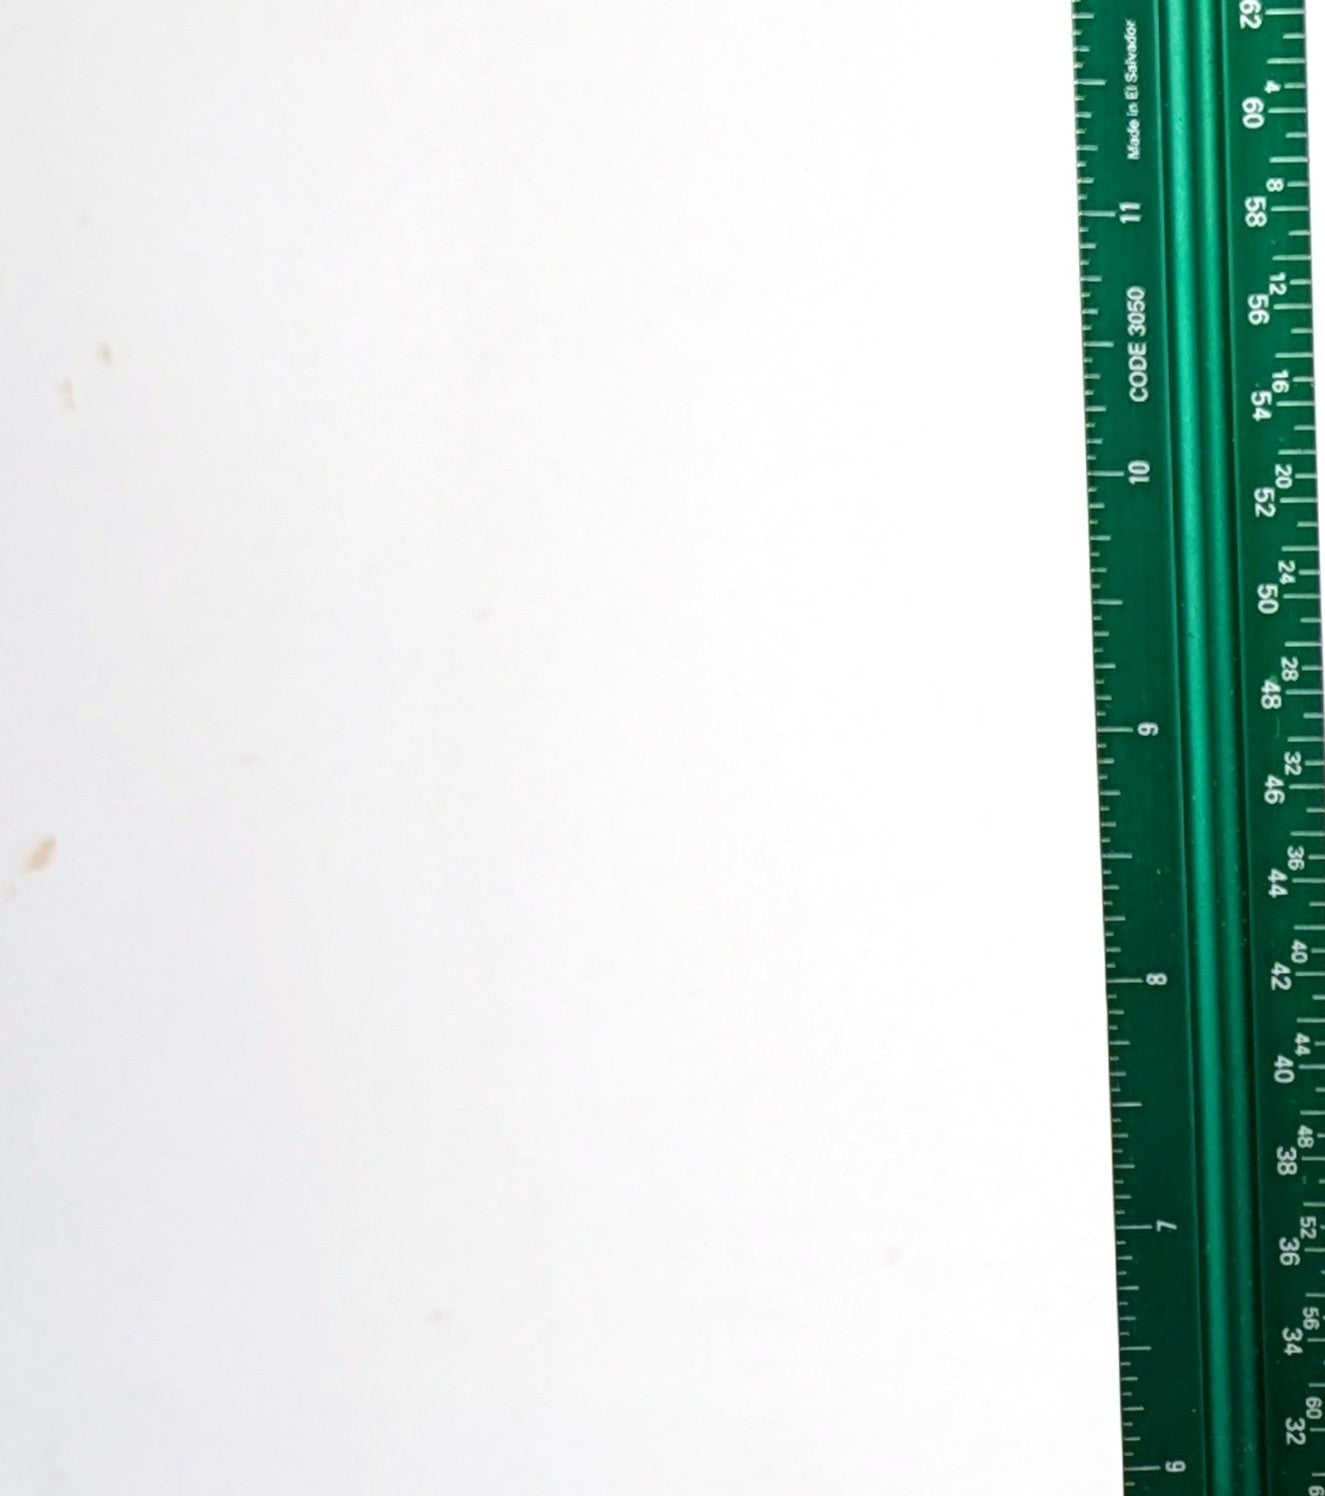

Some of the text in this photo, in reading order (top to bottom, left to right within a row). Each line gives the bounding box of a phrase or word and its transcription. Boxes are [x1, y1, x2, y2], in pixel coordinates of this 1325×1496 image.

[1239, 0, 1262, 29] 62
[1124, 18, 1140, 160] Made in El Salvador
[1264, 80, 1281, 93] 4
[1242, 97, 1265, 129] 60
[1266, 178, 1284, 192] 8
[1119, 202, 1141, 223] 11
[1245, 196, 1267, 227] 58
[1270, 272, 1287, 295] 12
[1247, 293, 1270, 325] 56
[1126, 286, 1148, 402] CODE 3050
[1271, 370, 1290, 393] 16
[1251, 390, 1272, 421] 54
[1127, 460, 1150, 485] 10
[1275, 464, 1293, 489] 20
[1253, 487, 1276, 518] 52
[1278, 560, 1296, 585] 24
[1257, 583, 1279, 614] 50
[1281, 656, 1299, 682] 28
[1260, 679, 1282, 709] 48
[1137, 722, 1159, 736] 9
[1284, 751, 1302, 775] 32
[1264, 774, 1285, 804] 46
[1287, 845, 1305, 871] 36
[1267, 868, 1288, 898] 44
[1291, 940, 1308, 964] 40
[1146, 972, 1167, 985] 8
[1271, 962, 1291, 990] 42
[1295, 1033, 1311, 1056] 44
[1274, 1055, 1295, 1084] 40
[1297, 1125, 1314, 1148] 48
[1276, 1146, 1297, 1176] 38
[1156, 1219, 1177, 1232] 7
[1300, 1216, 1316, 1239] 52
[1279, 1237, 1300, 1266] 36
[1303, 1306, 1319, 1331] 56
[1282, 1327, 1303, 1356] 34
[1305, 1397, 1322, 1419] 60
[1285, 1417, 1306, 1445] 32
[1165, 1460, 1186, 1473] 6
